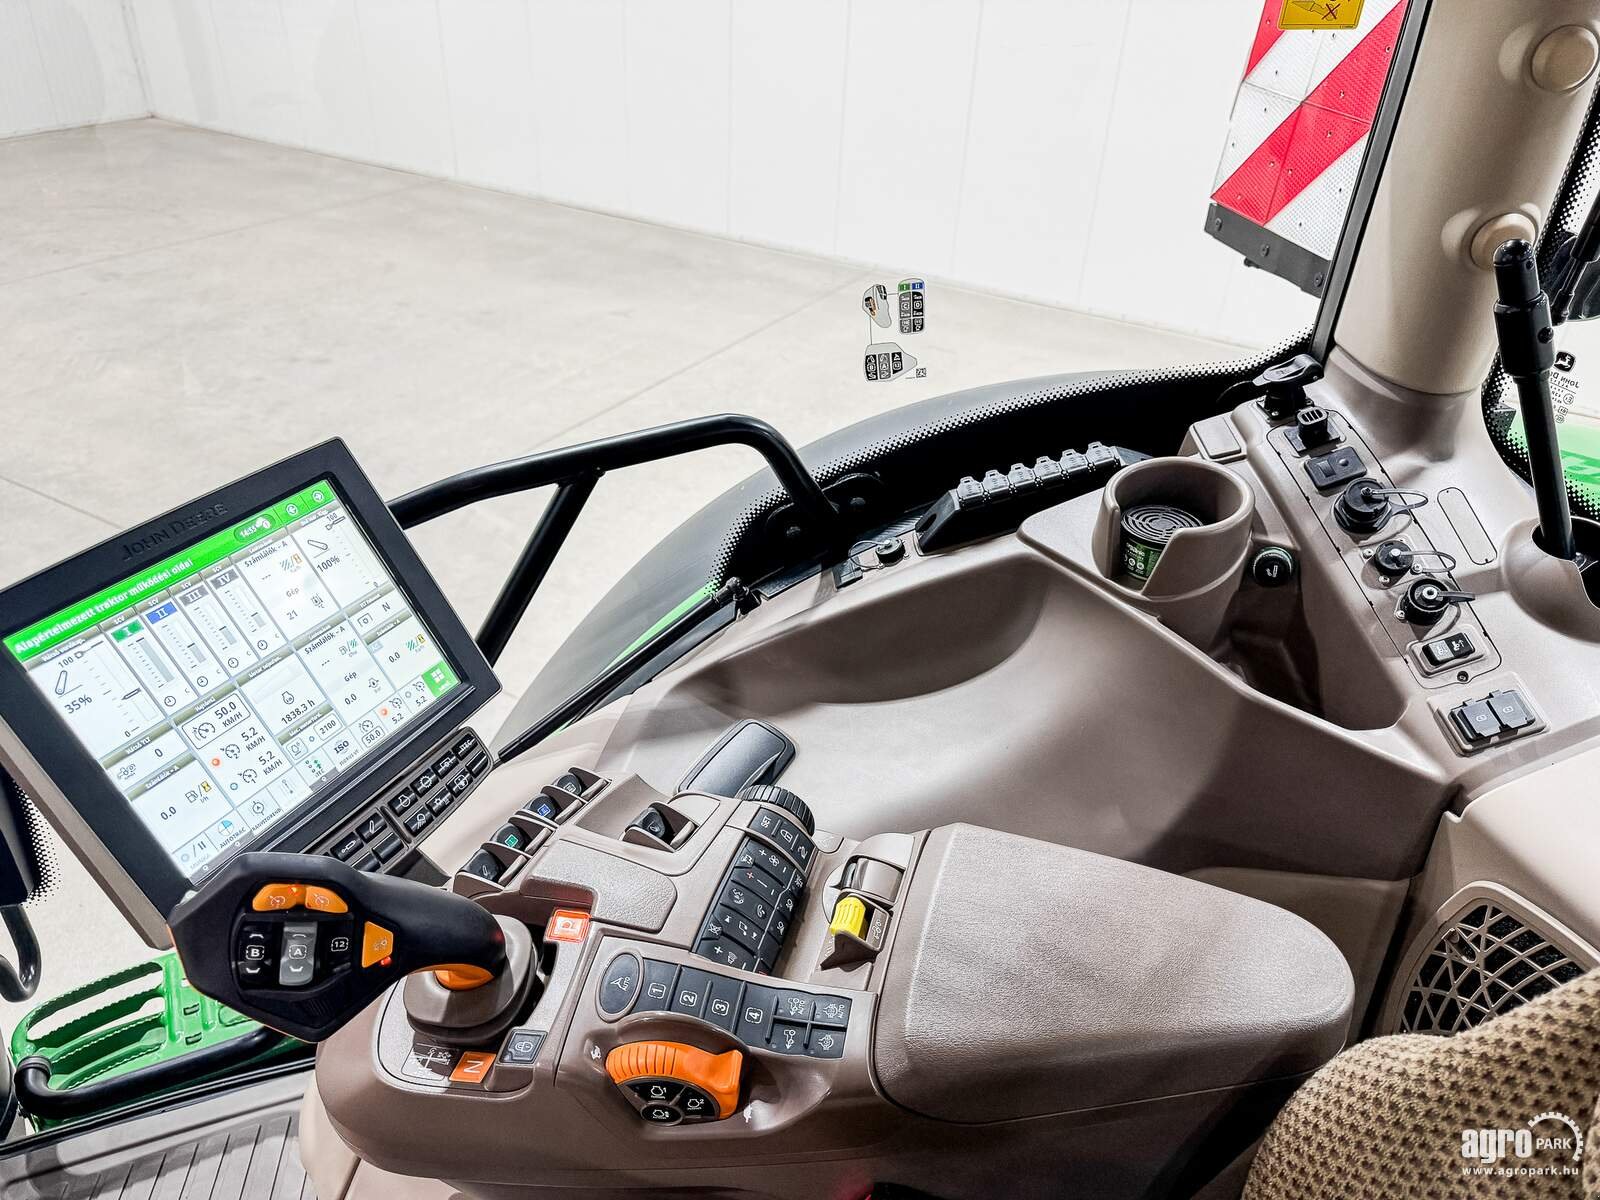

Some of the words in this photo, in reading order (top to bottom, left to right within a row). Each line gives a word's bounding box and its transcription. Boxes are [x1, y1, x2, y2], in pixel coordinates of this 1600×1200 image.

[326, 512, 337, 520] 100
[123, 530, 170, 561] JOHN
[168, 504, 228, 534] DEERE
[316, 555, 340, 572] 100%
[95, 592, 127, 611] traktor
[170, 559, 192, 573] oldal
[217, 573, 231, 585] IV
[186, 590, 202, 602] III
[285, 586, 299, 597] Gép
[155, 608, 168, 618] II
[382, 602, 390, 611] N
[286, 610, 297, 619] 21
[304, 632, 334, 653] Számlálók
[58, 656, 74, 667] 100
[389, 652, 400, 662] 0.0
[344, 671, 357, 683] Gép
[64, 694, 92, 713] 35%
[344, 693, 357, 704] 0.0
[415, 696, 426, 706] 5.2
[214, 701, 236, 718] 50.0
[281, 703, 307, 724] 1838.3
[222, 712, 242, 726] KM/H
[391, 712, 403, 723] 5.2
[319, 720, 336, 733] 2100
[241, 727, 257, 740] 5.2
[365, 730, 380, 743] 50.0
[246, 736, 265, 750] KM/H
[333, 740, 349, 753] ISO
[154, 748, 163, 756] 0
[258, 751, 274, 764] 5.2
[263, 760, 282, 774] KM/H
[160, 806, 177, 820] 0.0
[760, 816, 772, 828] SET
[219, 827, 246, 848] AUTOTRAC
[294, 948, 302, 956] A
[684, 995, 694, 1004] 2
[716, 1002, 726, 1012] 3
[797, 1000, 805, 1015] AUTO
[836, 1004, 844, 1019] AUTO
[750, 1012, 760, 1020] 4
[464, 1060, 483, 1074] N
